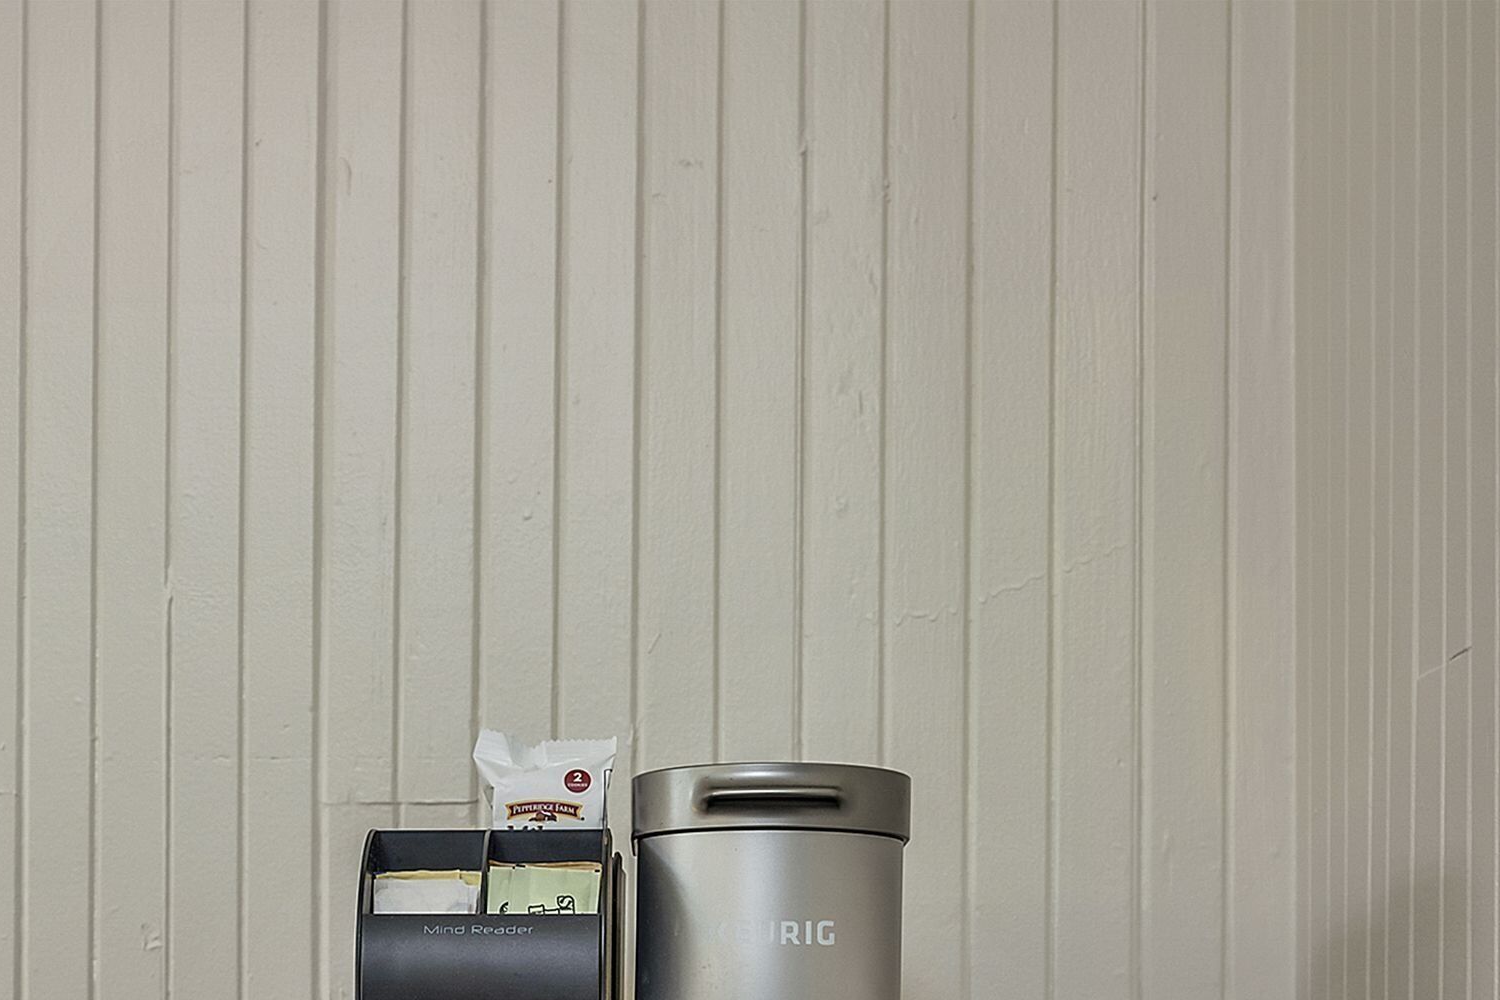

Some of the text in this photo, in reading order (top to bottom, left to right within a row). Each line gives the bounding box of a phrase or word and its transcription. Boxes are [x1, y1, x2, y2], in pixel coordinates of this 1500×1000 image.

[573, 772, 583, 783] 2
[512, 803, 575, 815] PEPPERIDGE FARM
[423, 924, 534, 935] Mind Reader
